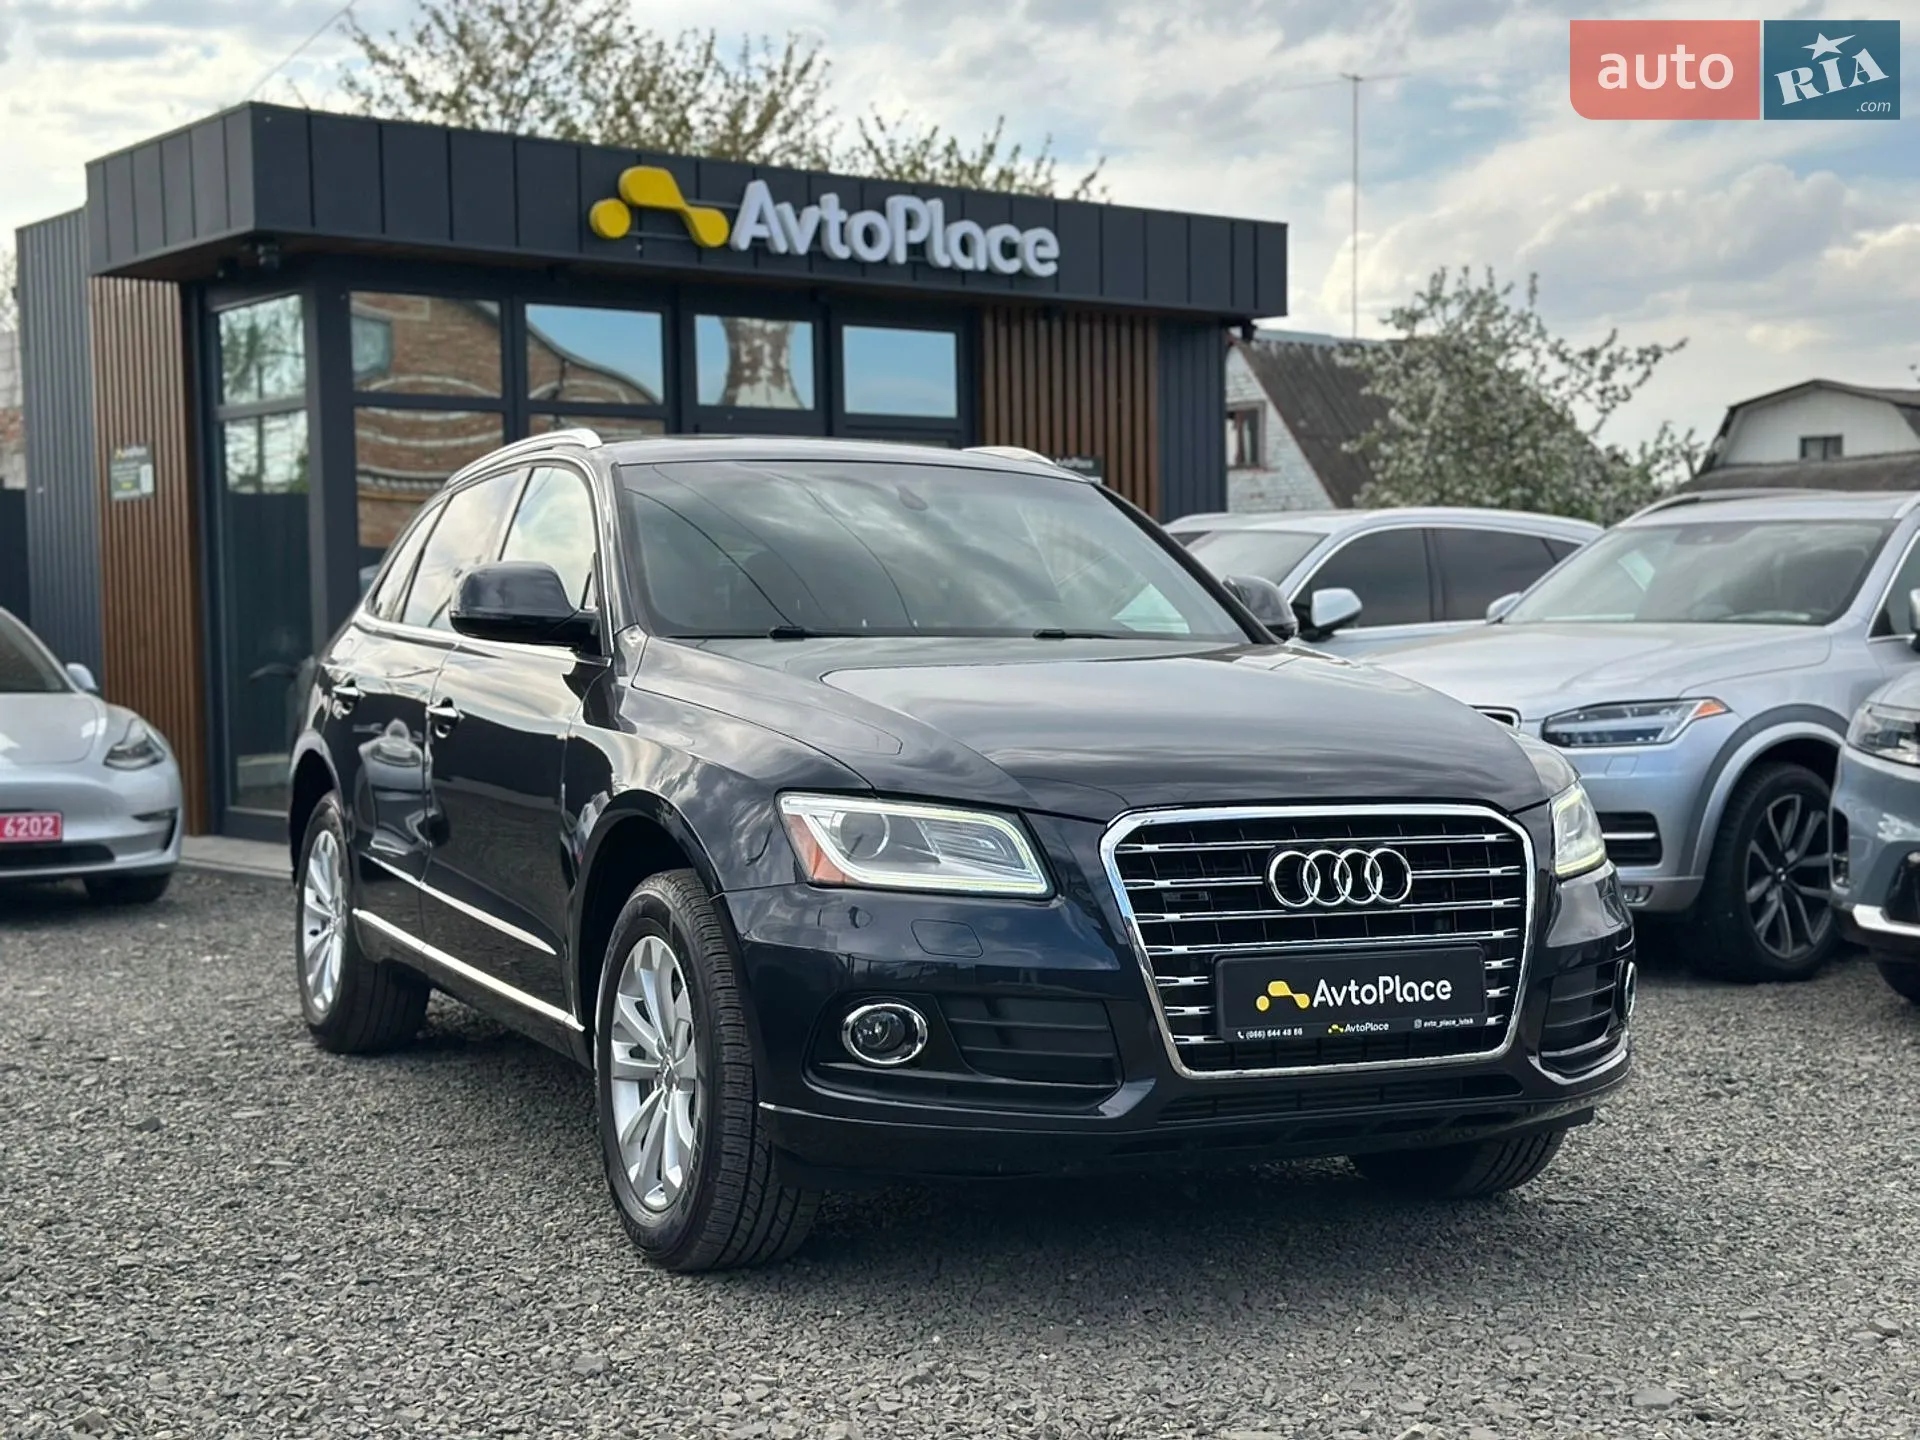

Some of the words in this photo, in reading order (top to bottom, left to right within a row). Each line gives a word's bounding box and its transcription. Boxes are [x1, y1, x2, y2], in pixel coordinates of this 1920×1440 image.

[731, 178, 1060, 278] AvtoPlace
[4, 815, 54, 837] 6202
[1313, 974, 1452, 1008] AvtoPlace
[1344, 1022, 1390, 1033] AvtoPlace
